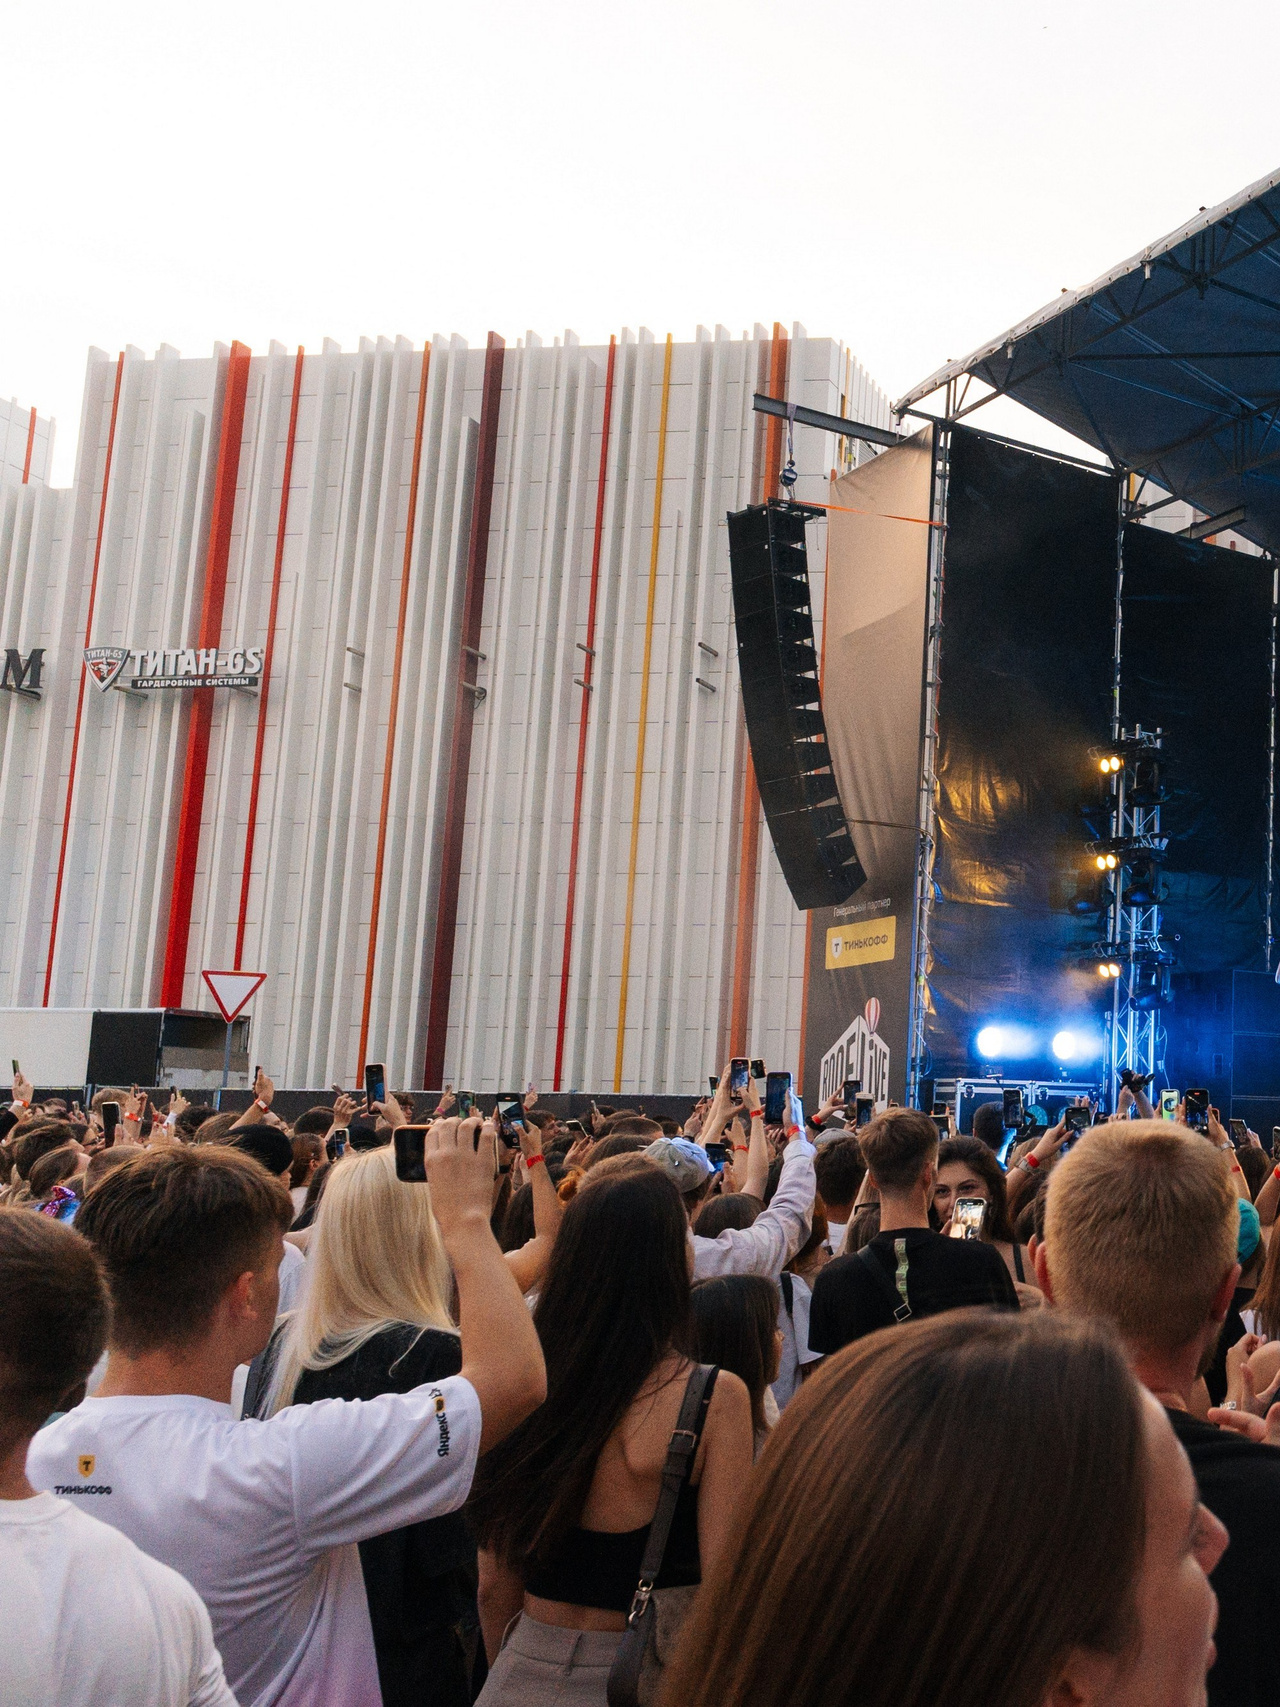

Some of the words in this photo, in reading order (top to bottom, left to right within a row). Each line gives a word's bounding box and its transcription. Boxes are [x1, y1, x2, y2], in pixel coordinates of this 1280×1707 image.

[130, 647, 263, 676] ТИТАН-GS
[137, 679, 203, 688] ГАРДЕРОБНЫЕ
[205, 677, 249, 686] СИСТЕМЫ
[844, 934, 888, 951] ТИНЬКОФФ
[822, 1031, 857, 1102] ROOF
[435, 1411, 450, 1457] Яндекс
[54, 1485, 113, 1495] ТИНЬКОФФ
